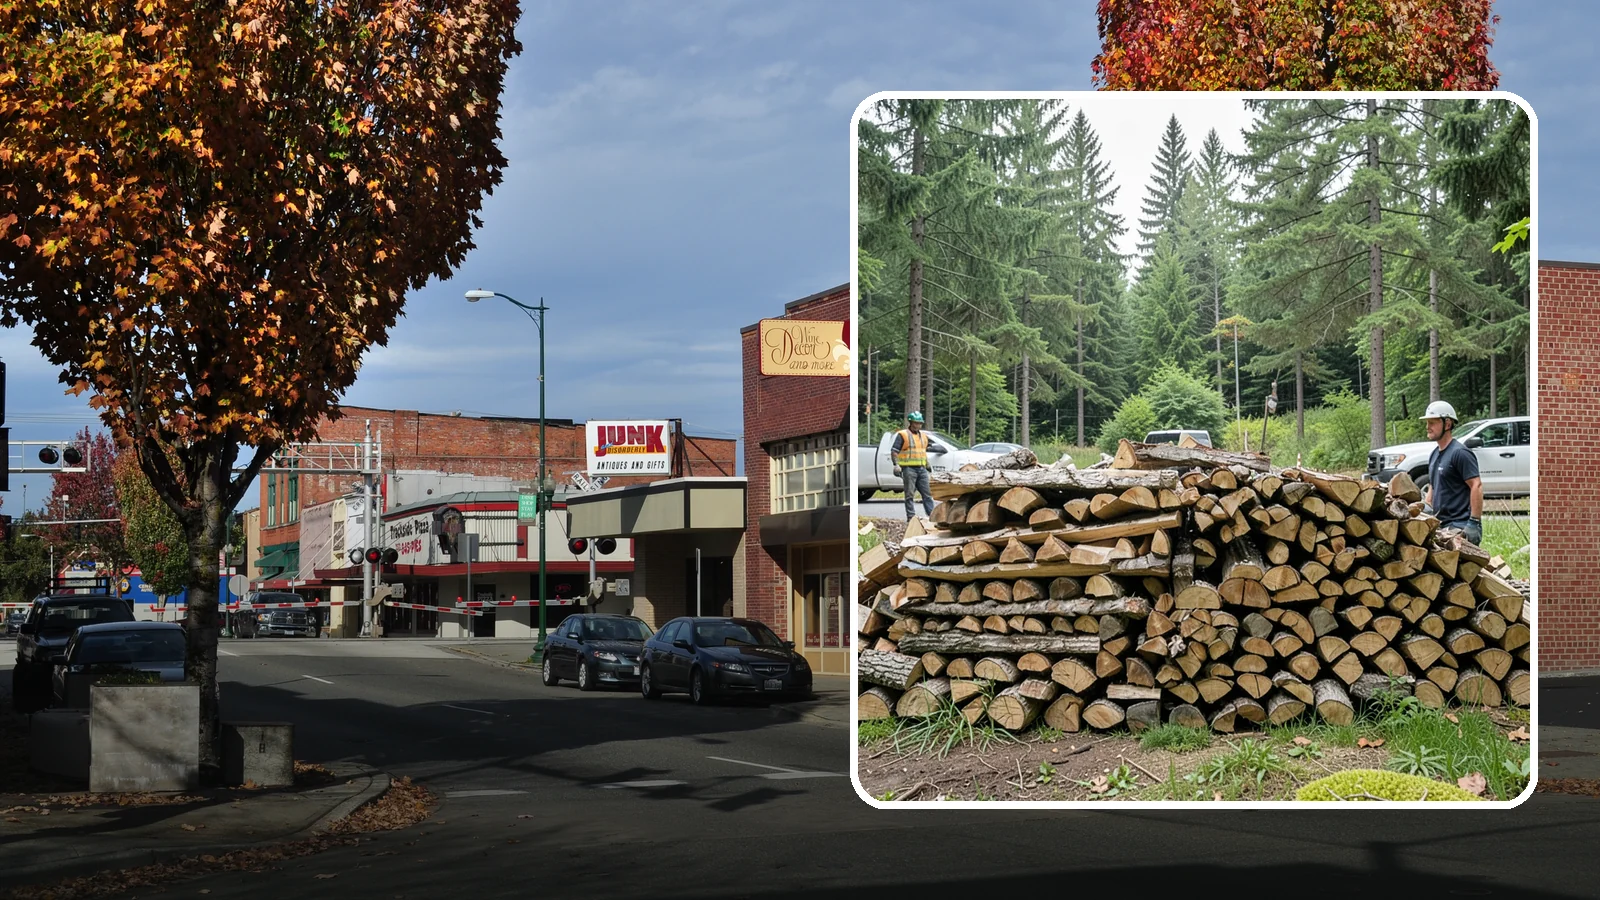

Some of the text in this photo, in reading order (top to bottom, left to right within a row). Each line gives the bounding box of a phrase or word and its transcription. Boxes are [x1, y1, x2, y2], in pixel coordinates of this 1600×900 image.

[764, 327, 831, 365] Decor
[595, 425, 665, 457] JUNK
[607, 446, 646, 454] DISORDERLY
[596, 460, 665, 470] ANTIQUES AND GIFTS
[414, 519, 429, 535] Pizza
